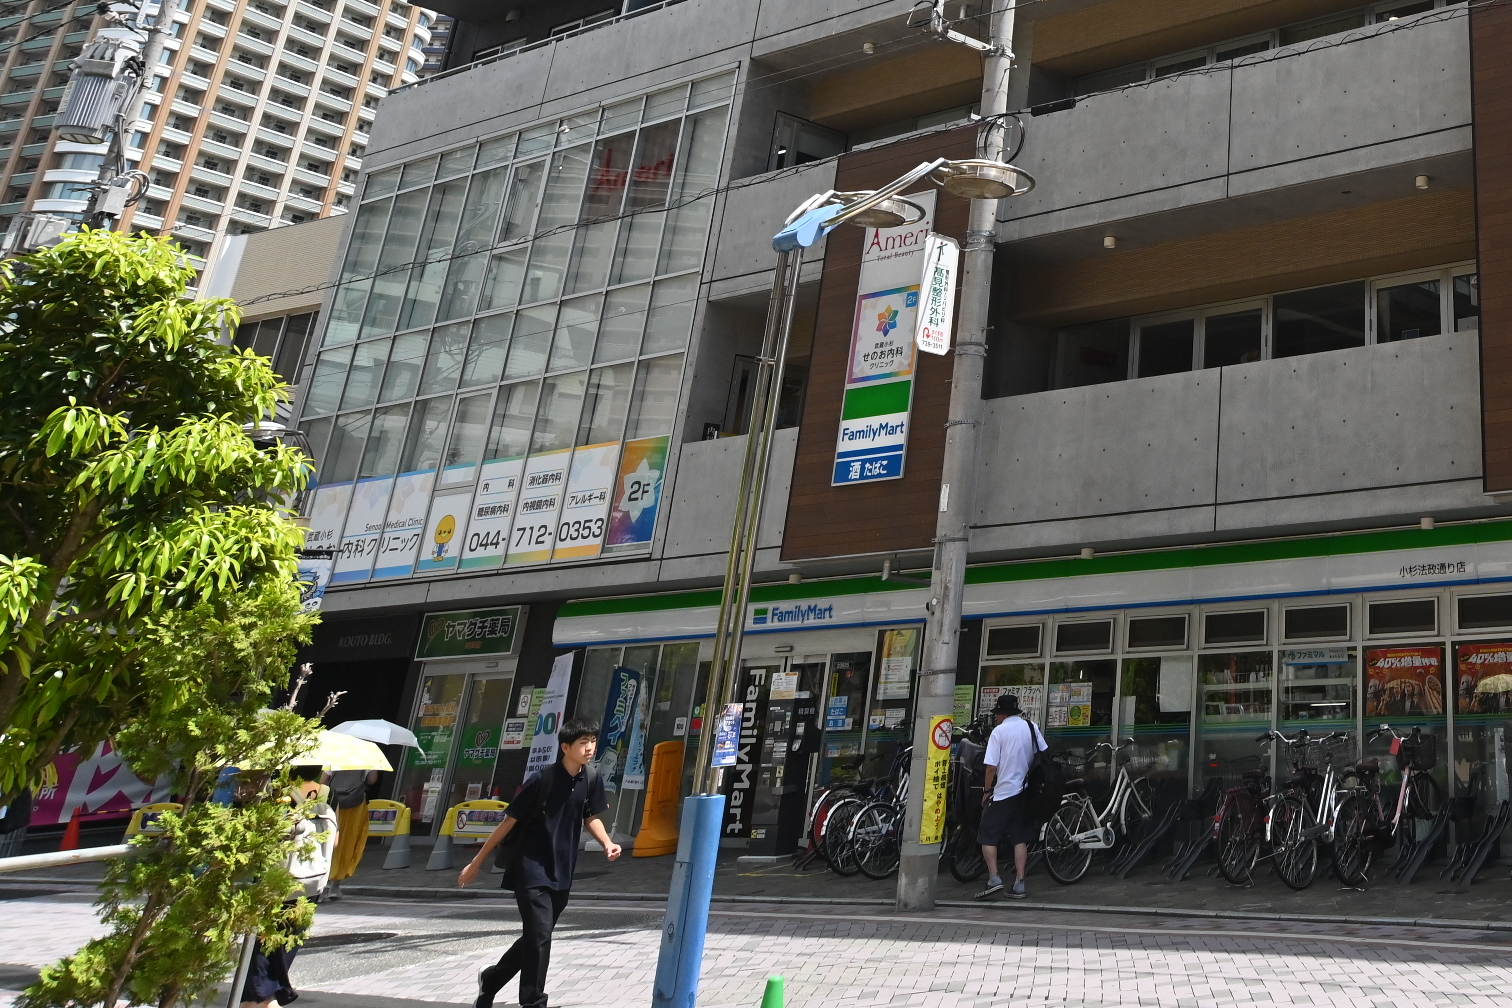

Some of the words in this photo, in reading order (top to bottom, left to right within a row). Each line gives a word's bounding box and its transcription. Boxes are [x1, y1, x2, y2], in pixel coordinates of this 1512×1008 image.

[907, 295, 917, 305] 2F
[874, 340, 894, 350] 武蔵小杉
[862, 346, 904, 362] せのお内科
[869, 359, 894, 370] クリニック
[841, 420, 905, 442] FamilyMart
[848, 461, 861, 480] 酒
[863, 459, 888, 477] たばこ
[528, 472, 562, 487] 消化器内科
[569, 490, 606, 506] アレルギー科
[627, 480, 651, 502] 2F
[476, 503, 510, 518] 糖尿病内科
[521, 497, 556, 513] 内視鏡内科
[385, 518, 408, 530] Medical
[408, 517, 424, 527] Clinic
[1398, 561, 1467, 578] 小杉法政通り店
[770, 603, 834, 624] FamilyMart
[444, 616, 512, 641] ヤマグチ薬局
[726, 668, 767, 834] FamilyMart
